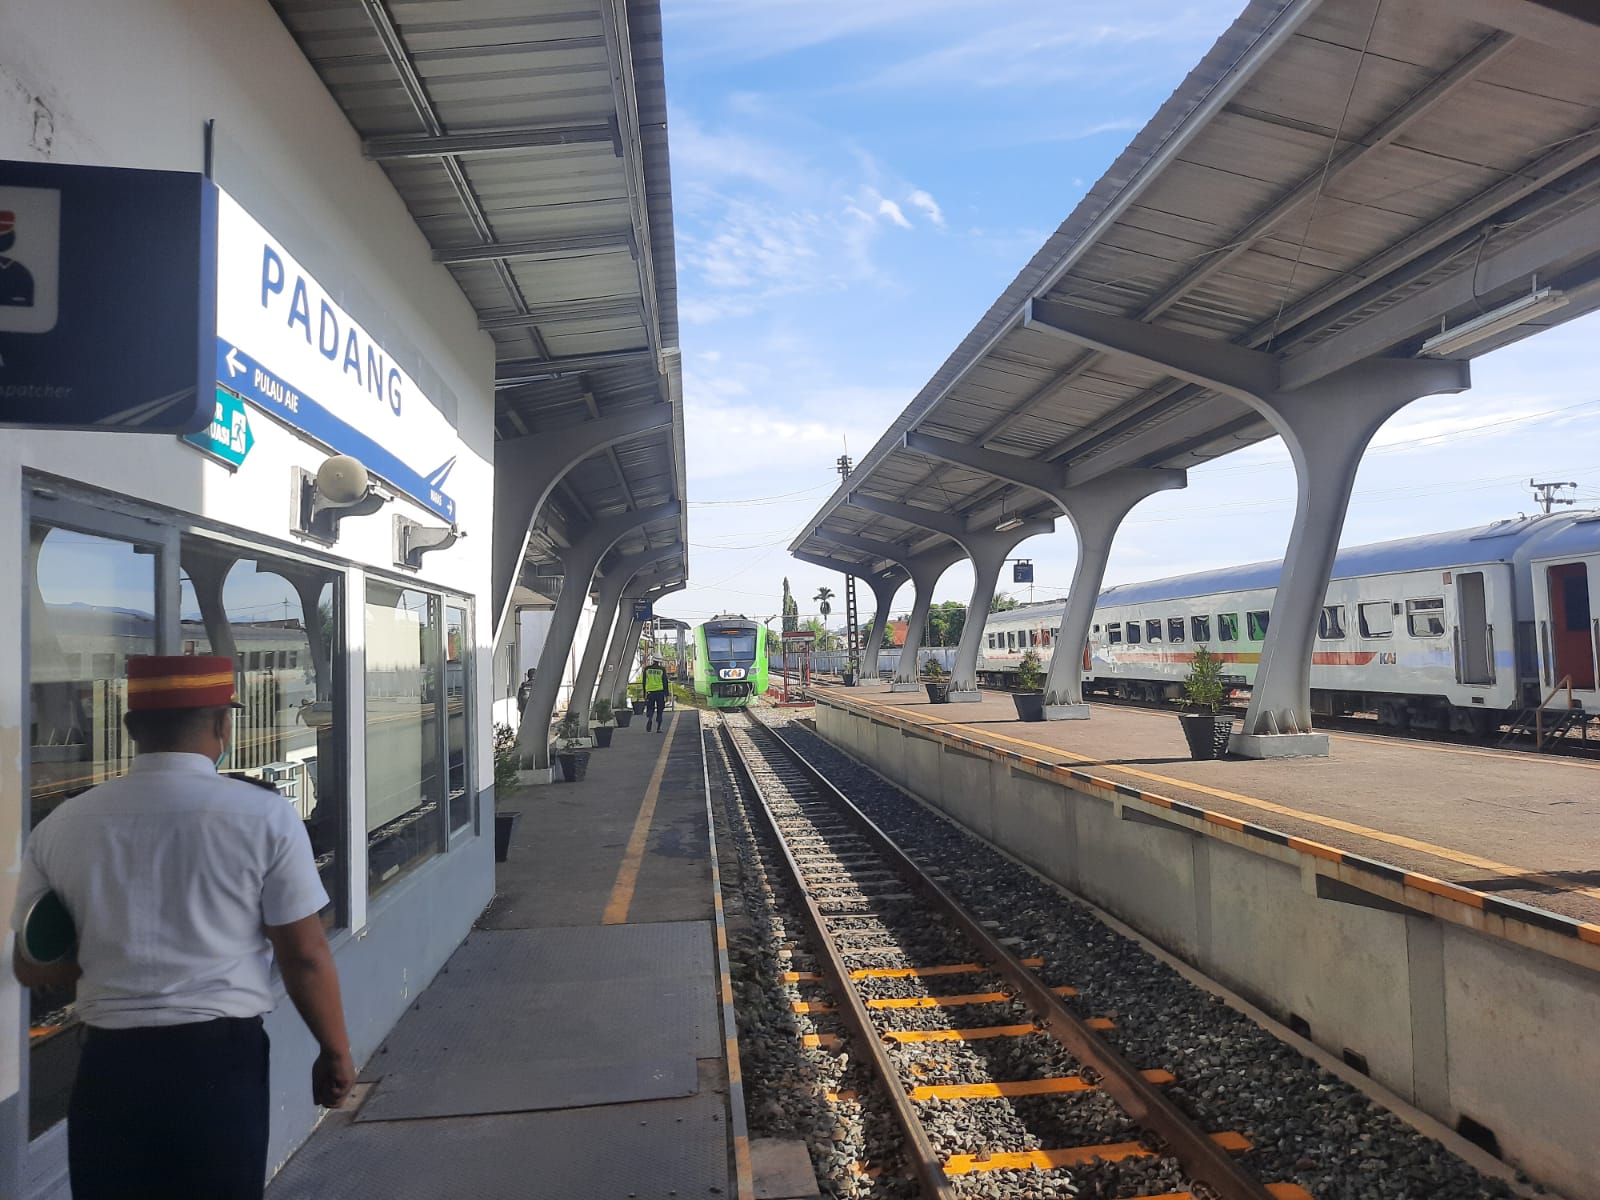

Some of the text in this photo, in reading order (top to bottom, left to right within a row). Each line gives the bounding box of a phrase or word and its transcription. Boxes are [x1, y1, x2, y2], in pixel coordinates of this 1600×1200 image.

[261, 243, 402, 417] PADANG
[254, 368, 299, 414] PULAU AIE
[208, 421, 231, 447] UASI
